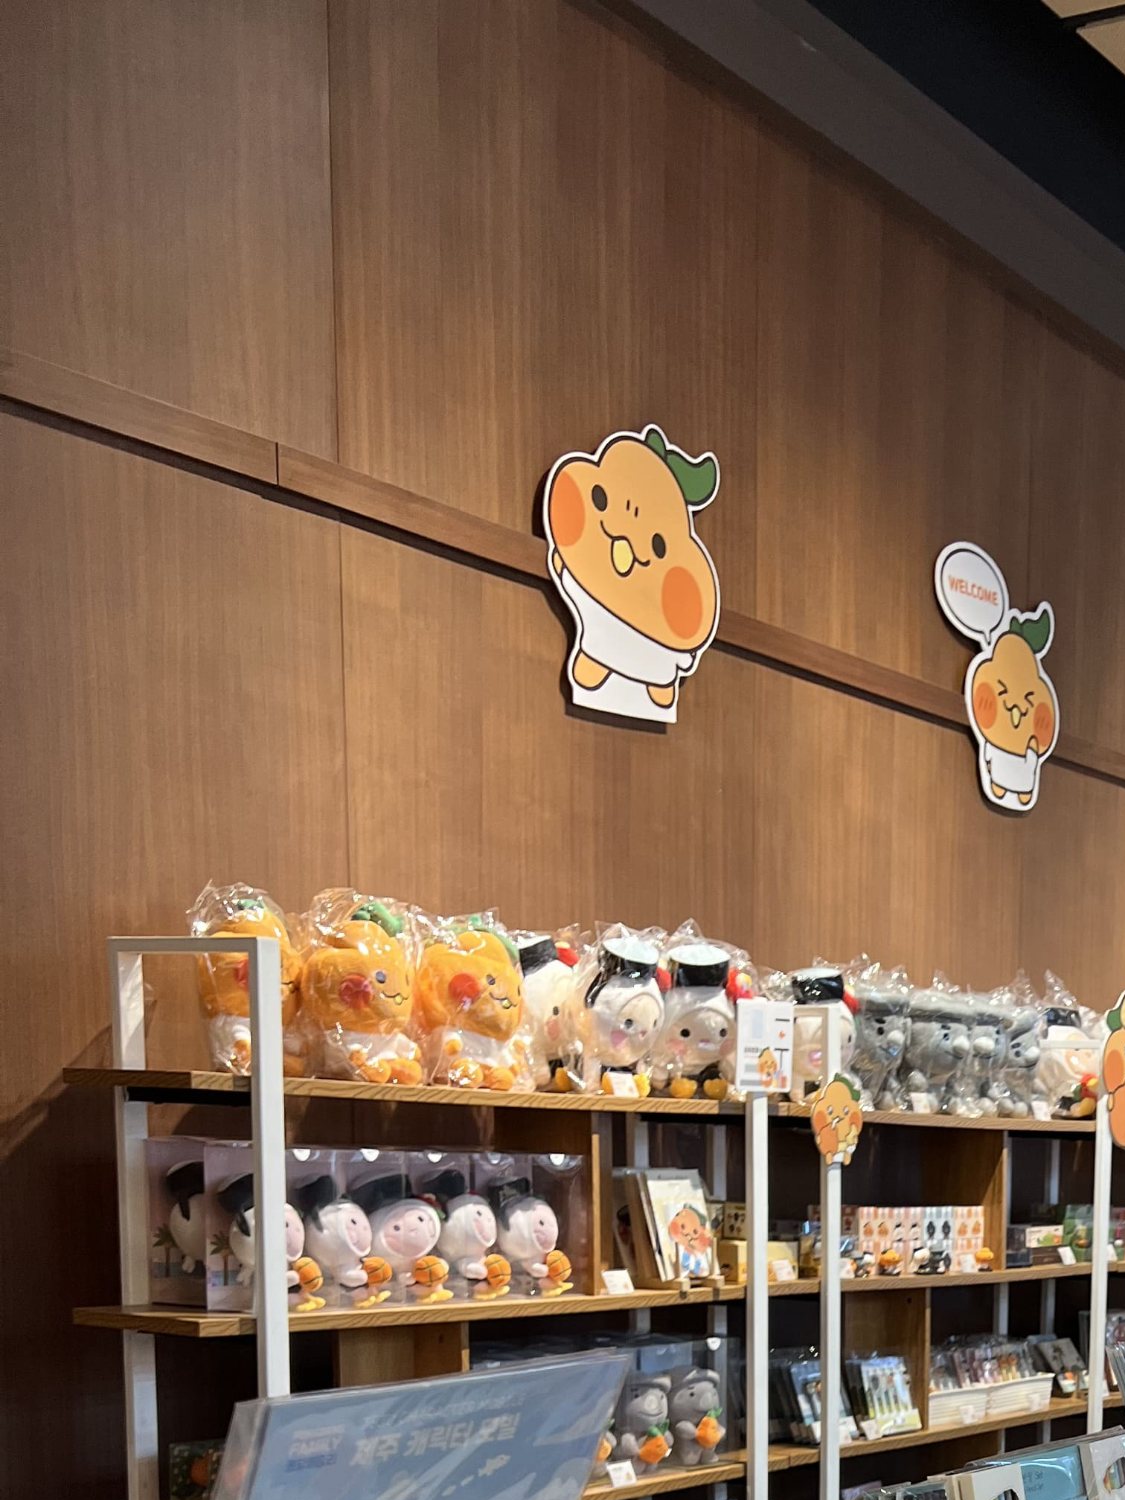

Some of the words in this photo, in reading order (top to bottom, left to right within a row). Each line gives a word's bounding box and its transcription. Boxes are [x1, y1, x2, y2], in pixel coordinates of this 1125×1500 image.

[948, 575, 998, 607] WELCOME
[351, 1432, 402, 1466] 제주
[403, 1421, 476, 1457] 캐릭터
[476, 1412, 522, 1445] 모빌
